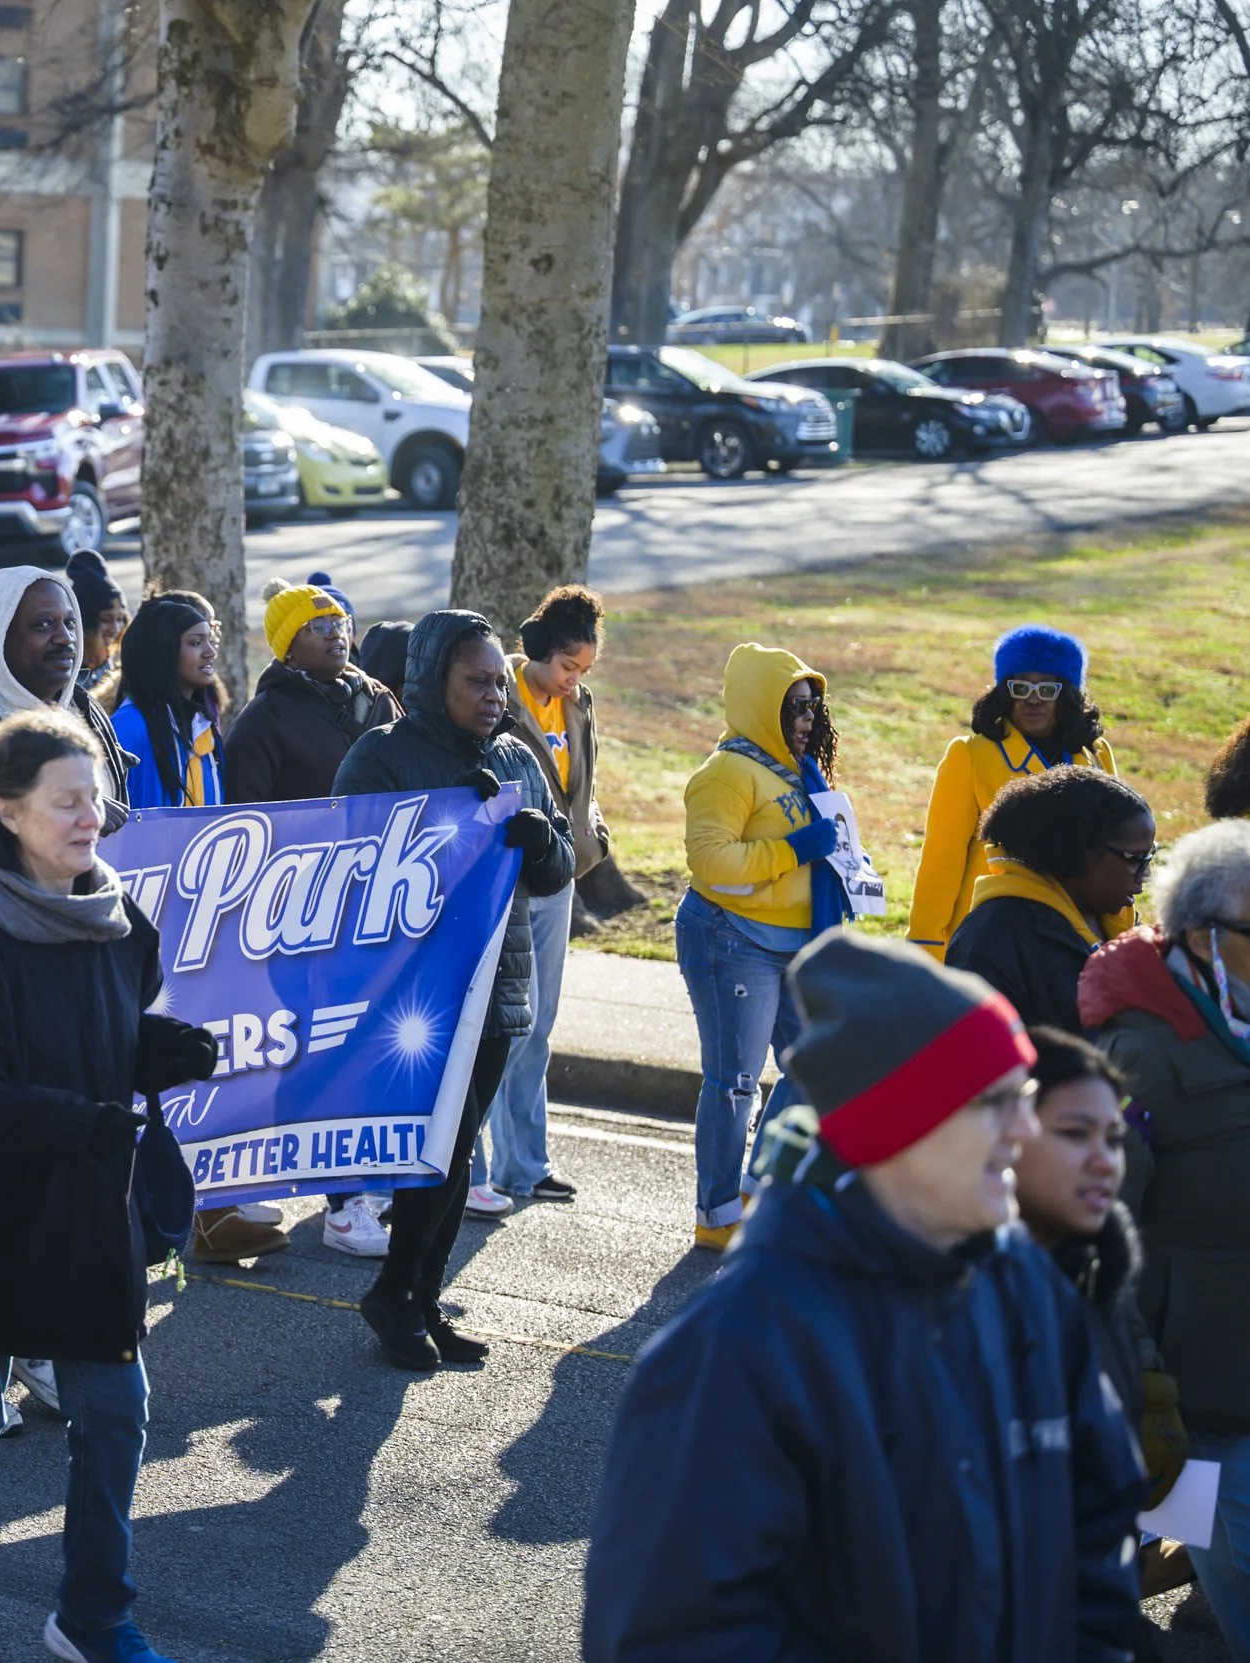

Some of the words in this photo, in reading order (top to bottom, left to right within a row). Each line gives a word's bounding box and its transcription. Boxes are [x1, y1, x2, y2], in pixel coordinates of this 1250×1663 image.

[173, 794, 459, 973] Park
[202, 1008, 298, 1078] ERS
[193, 1133, 300, 1185] BETTER
